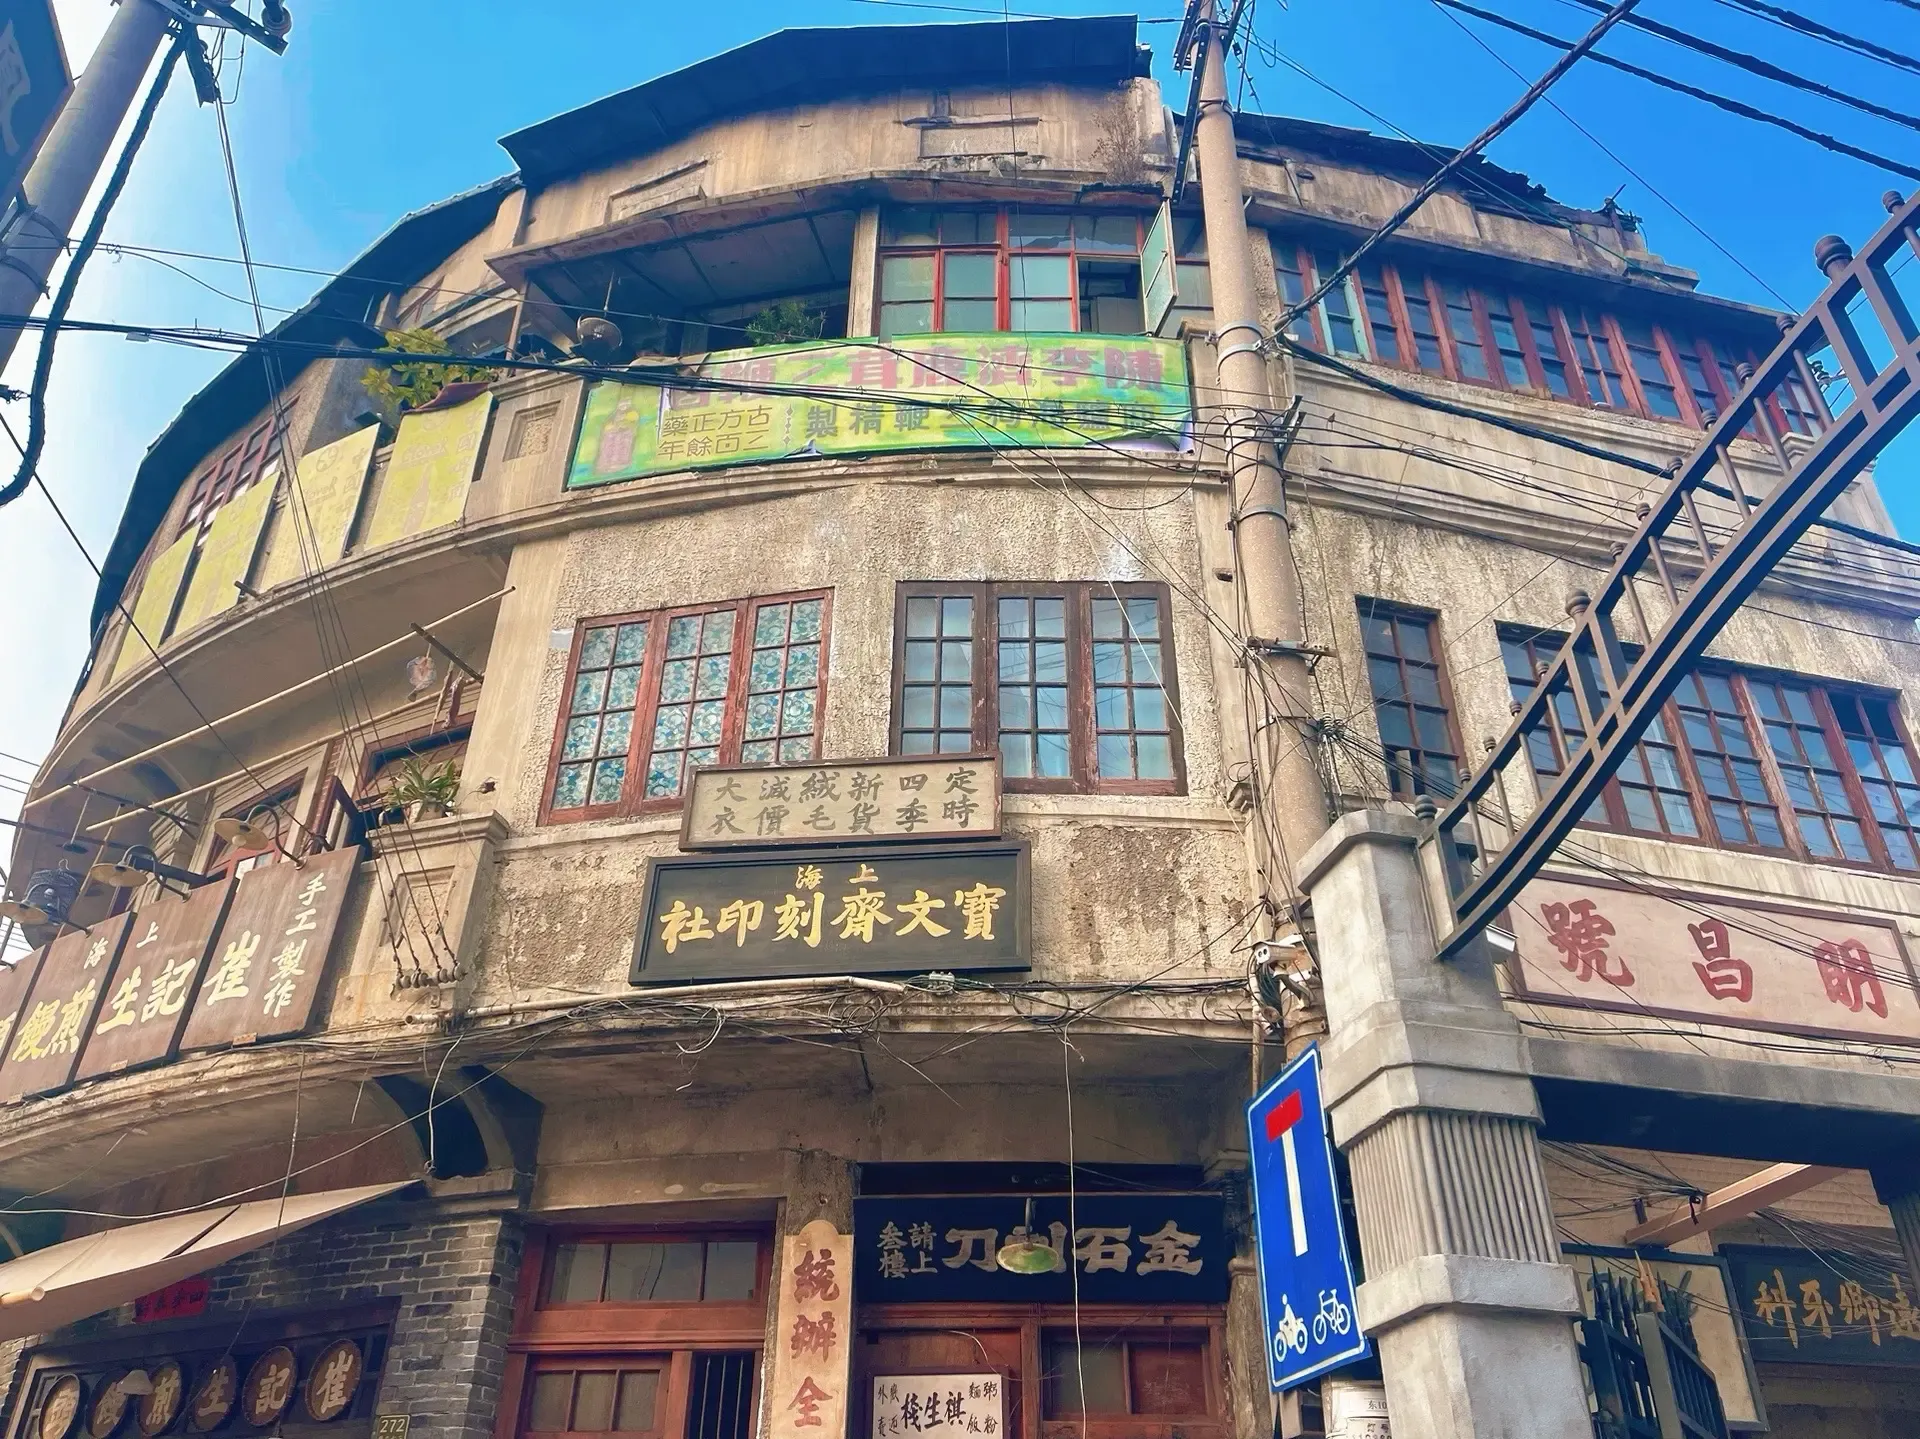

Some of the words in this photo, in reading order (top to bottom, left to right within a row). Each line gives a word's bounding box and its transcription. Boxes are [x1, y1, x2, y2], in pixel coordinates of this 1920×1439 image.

[795, 863, 880, 890] 上海
[263, 872, 327, 1018] 手工製作
[380, 1419, 405, 1433] 272
